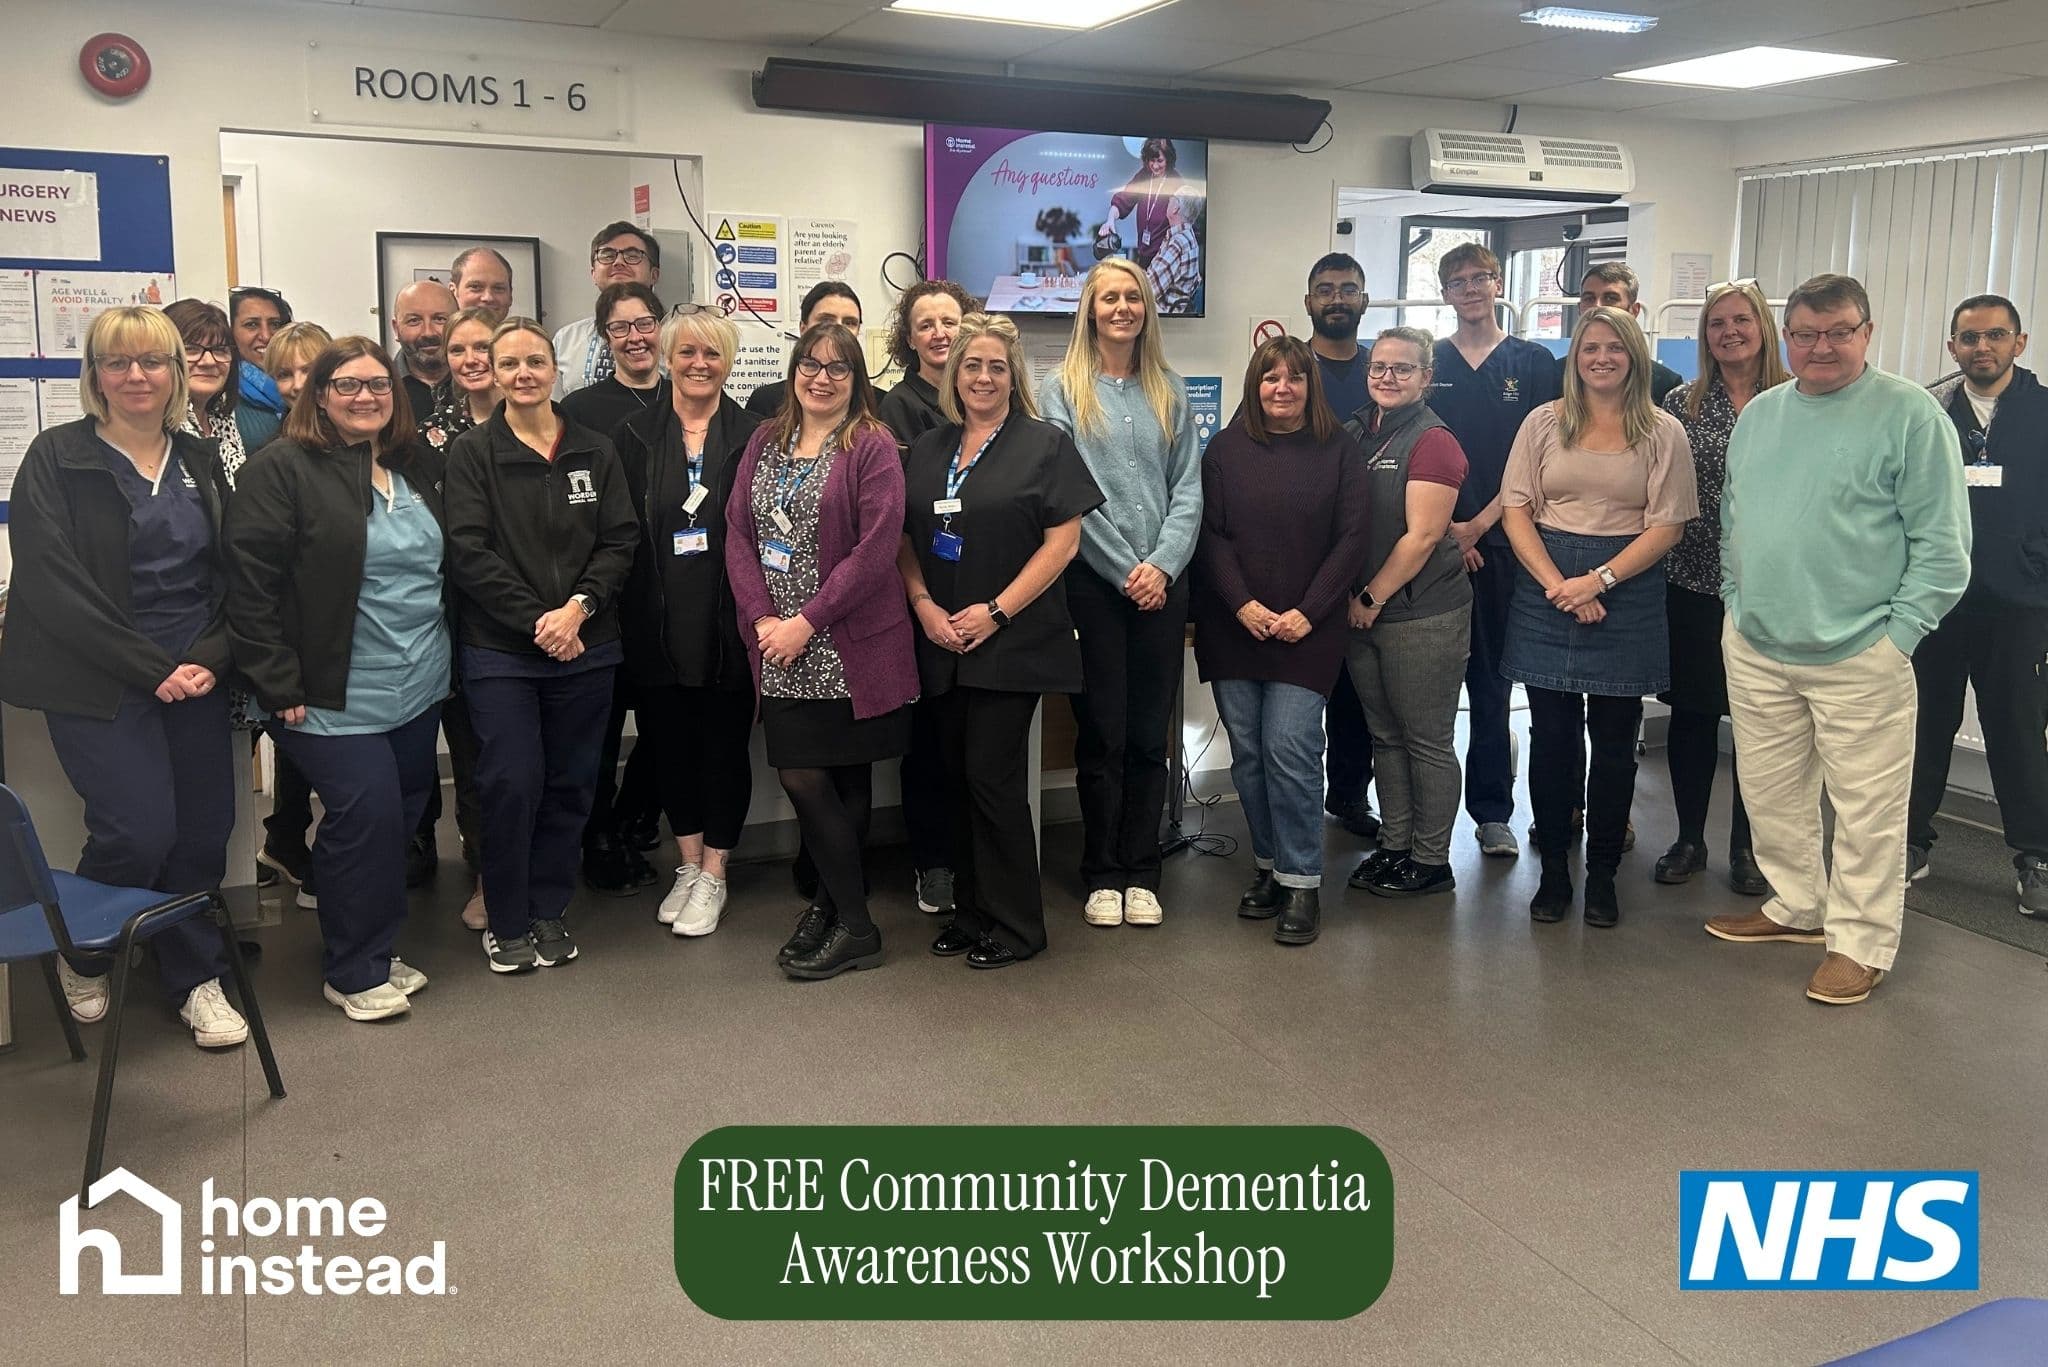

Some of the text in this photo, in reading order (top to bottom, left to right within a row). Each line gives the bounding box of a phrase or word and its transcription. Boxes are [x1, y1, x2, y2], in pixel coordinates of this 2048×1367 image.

[355, 66, 499, 106] ROOMS
[512, 79, 531, 108] 1
[567, 83, 587, 112] 6
[991, 158, 1099, 195] Any questions
[0, 208, 57, 224] NEWS
[794, 231, 806, 239] Are
[822, 231, 847, 241] looking
[794, 239, 811, 247] after
[822, 240, 845, 249] elderly
[51, 288, 70, 296] AGE
[74, 288, 98, 296] WELL
[52, 296, 82, 304] AVOID
[766, 345, 780, 354] the
[744, 357, 779, 366] sanitiser
[747, 369, 783, 380] entering
